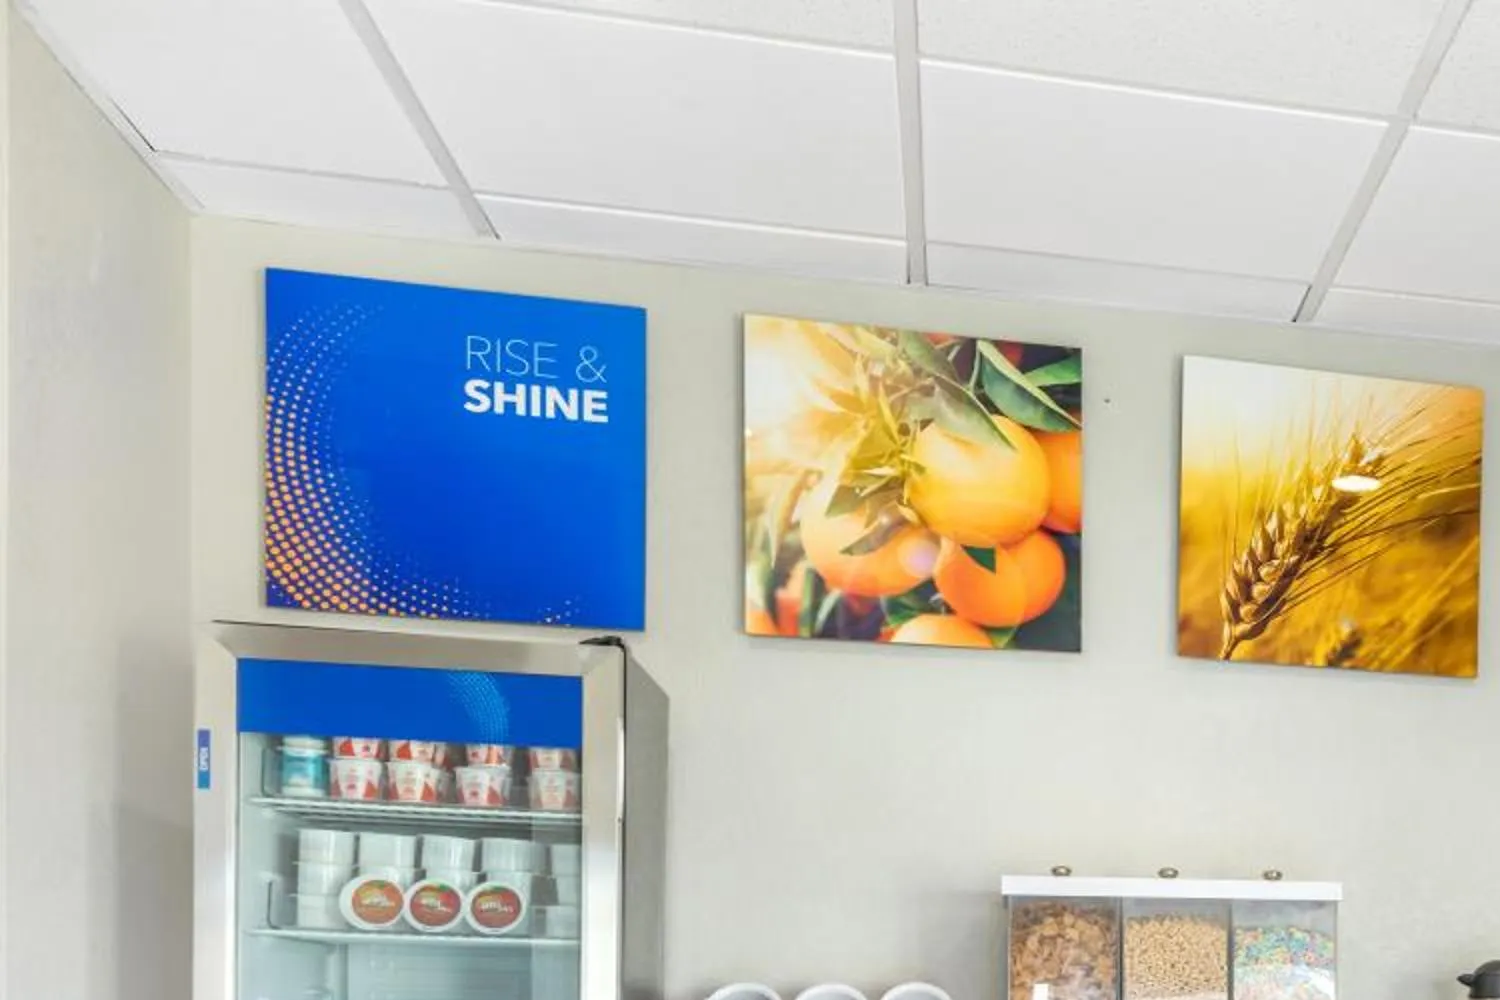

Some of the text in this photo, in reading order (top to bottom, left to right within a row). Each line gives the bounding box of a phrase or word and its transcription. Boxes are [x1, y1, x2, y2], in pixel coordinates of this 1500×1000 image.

[466, 335, 607, 383] RISE &
[463, 378, 609, 423] SHINE
